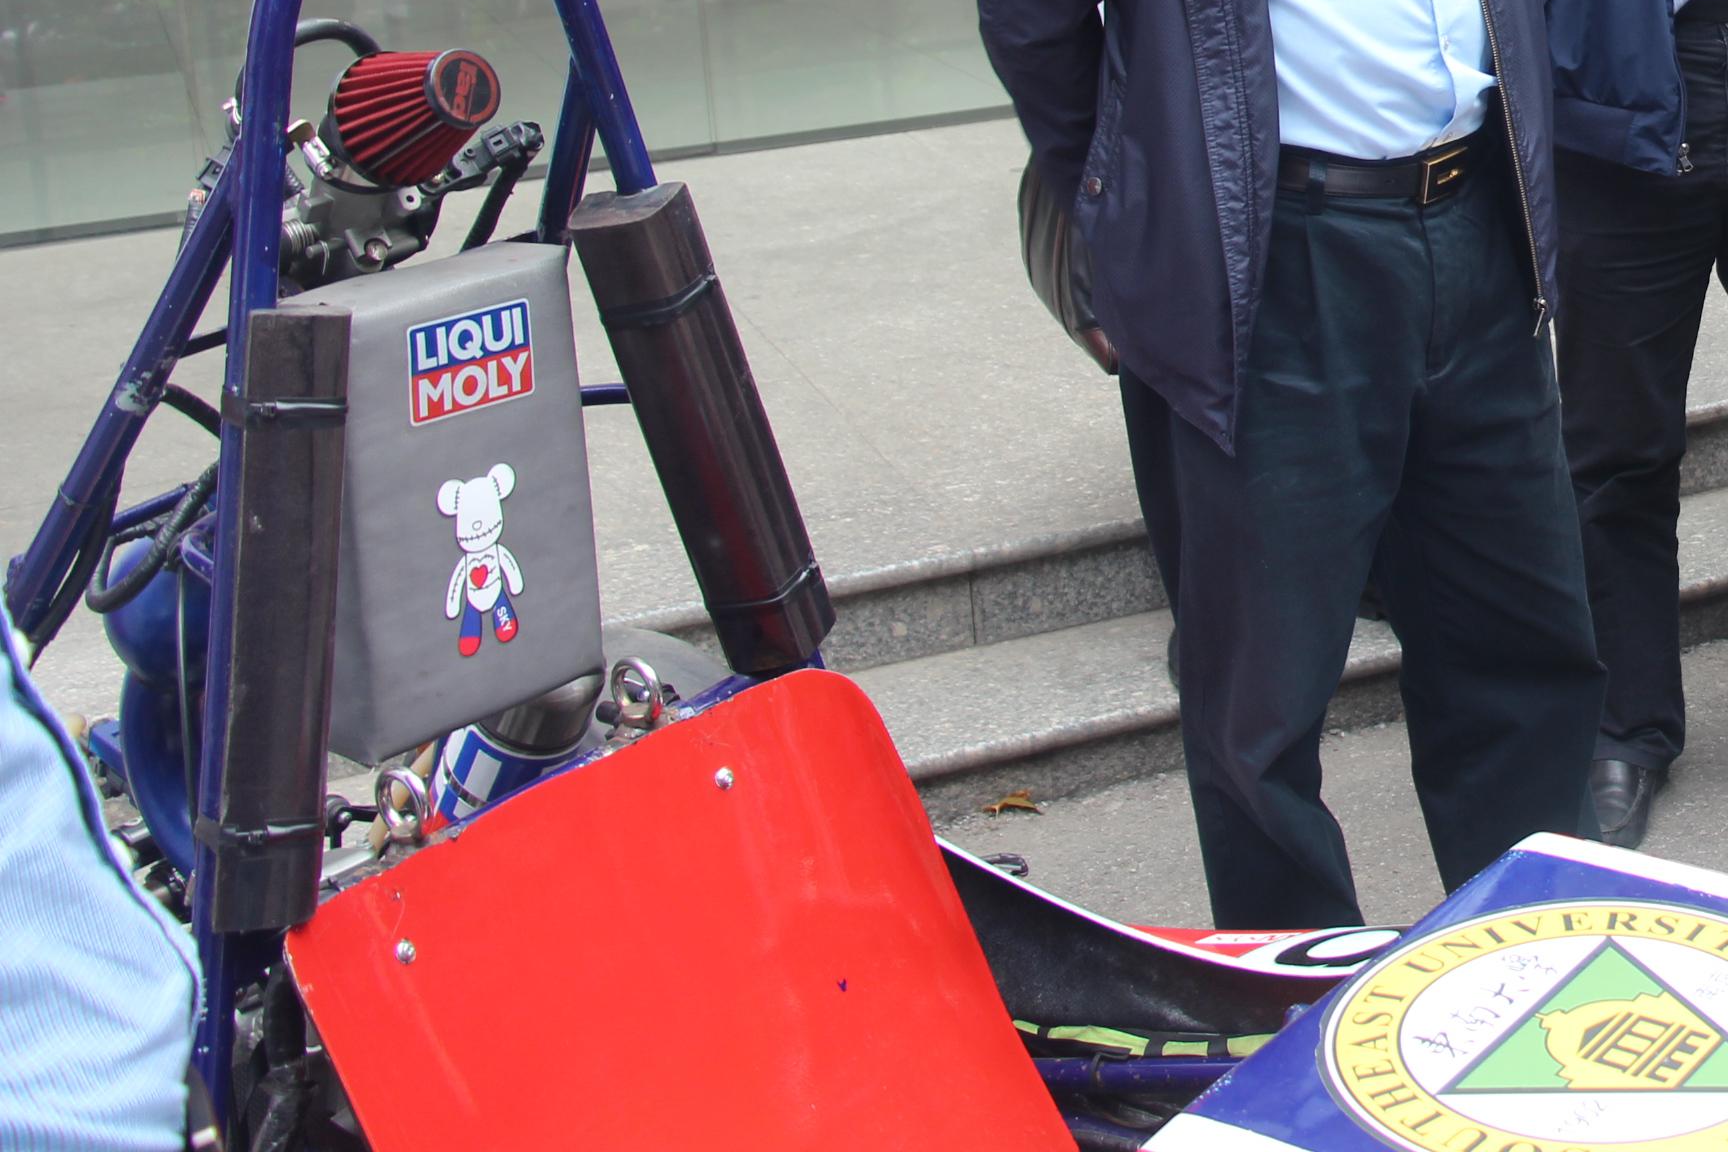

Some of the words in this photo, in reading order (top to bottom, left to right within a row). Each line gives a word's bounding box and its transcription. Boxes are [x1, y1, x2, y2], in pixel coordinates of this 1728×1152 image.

[415, 306, 524, 372] LIQUI
[417, 350, 529, 419] MOLY
[495, 605, 513, 633] SKY
